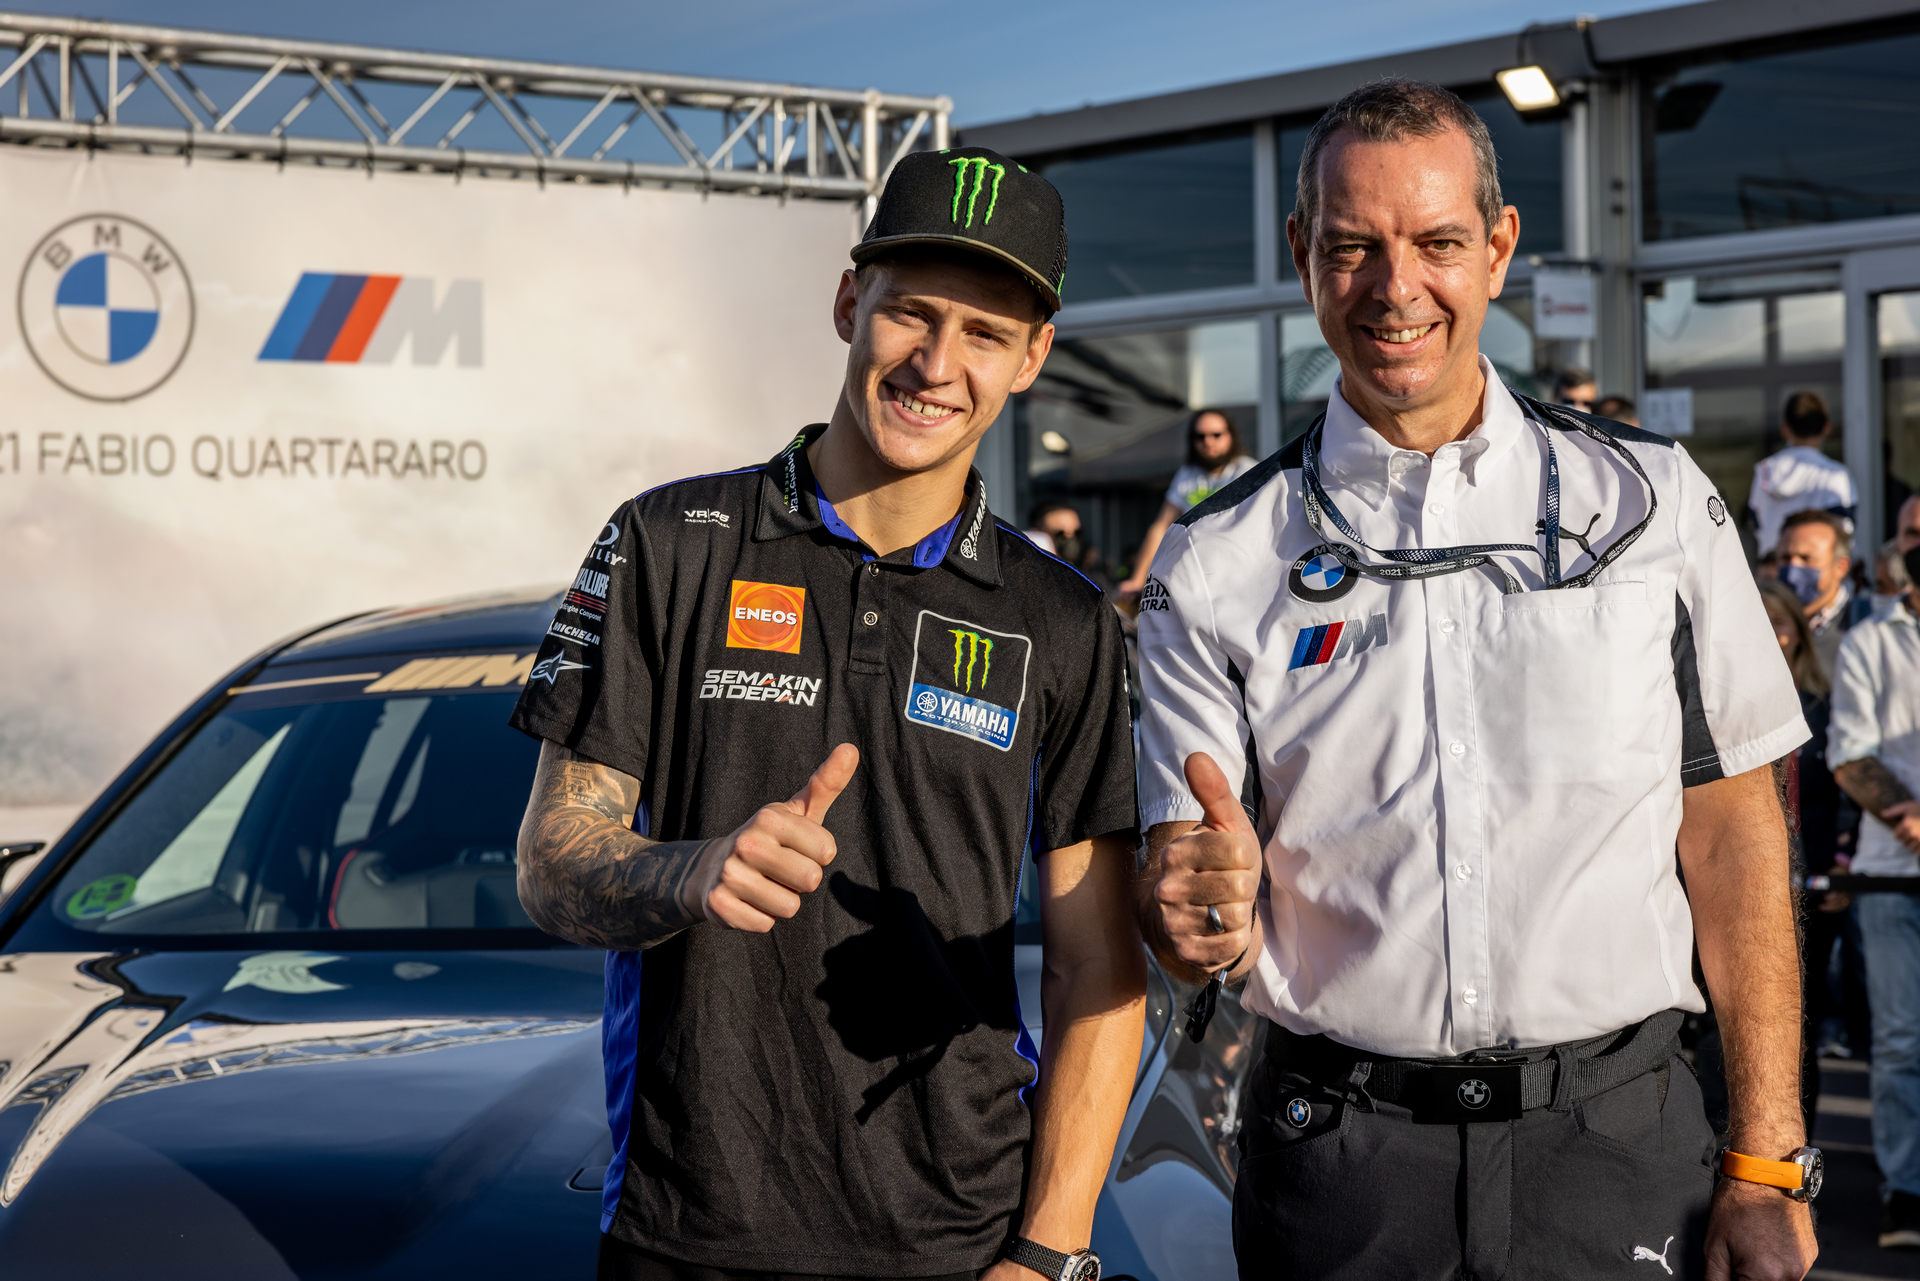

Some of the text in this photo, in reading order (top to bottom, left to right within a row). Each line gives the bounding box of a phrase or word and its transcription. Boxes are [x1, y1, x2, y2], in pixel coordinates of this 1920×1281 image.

[42, 223, 171, 275] BMW
[37, 432, 176, 478] FABIO
[190, 434, 488, 481] QUARTARARO
[788, 452, 799, 514] MONSTER
[1292, 545, 1352, 571] BMW
[1445, 546, 1491, 558] SATURDAY
[1380, 568, 1403, 576] 2021
[735, 607, 797, 626] ENEOS
[552, 622, 601, 646] MICHELIN
[726, 684, 817, 706] DEPAN
[914, 710, 1007, 742] FACTORY RACING
[940, 696, 1010, 737] YAMAHA
[1460, 1080, 1488, 1090] BMW
